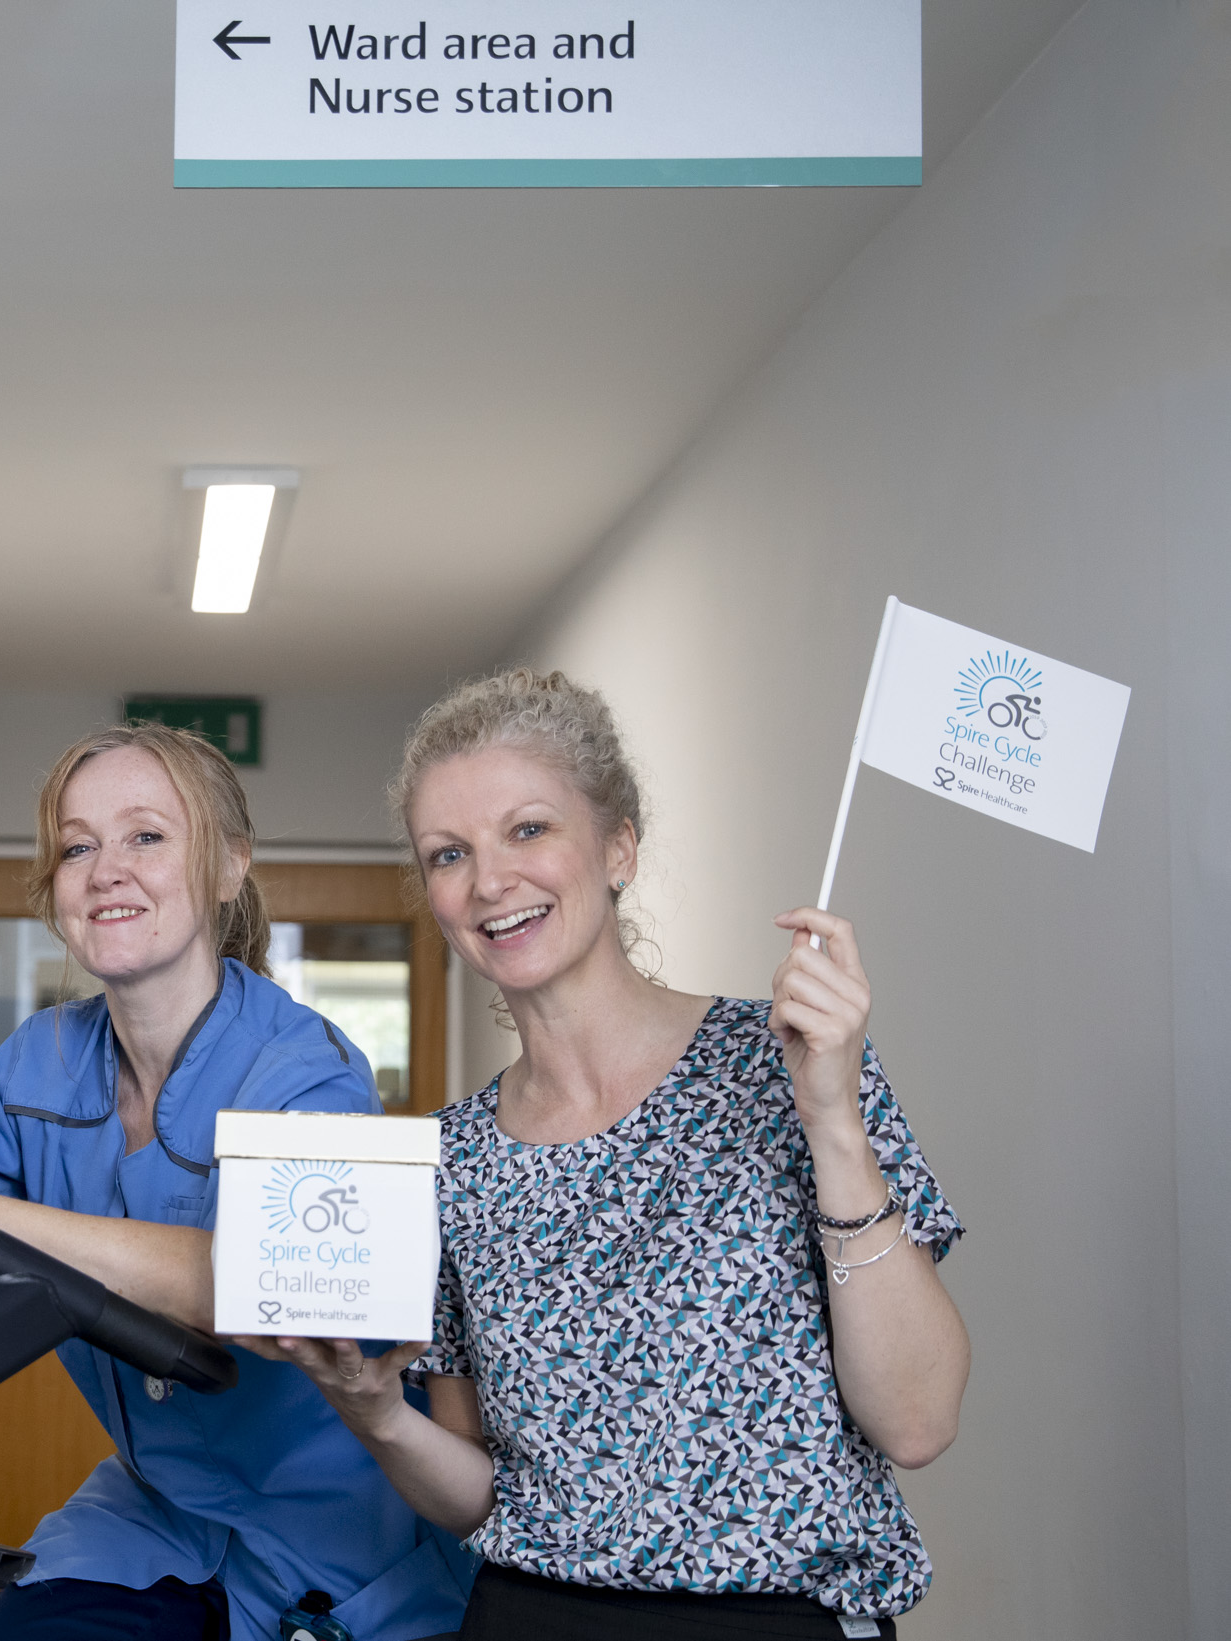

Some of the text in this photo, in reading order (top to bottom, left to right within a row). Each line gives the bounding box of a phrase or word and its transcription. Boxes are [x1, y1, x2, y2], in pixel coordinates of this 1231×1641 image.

[308, 20, 636, 61] Ward area and
[308, 76, 614, 115] Nurse station
[944, 716, 1042, 767] Spire Cycle
[940, 742, 1036, 794] Challenge
[957, 780, 1028, 814] Spire Healthcare
[259, 1239, 370, 1269] Spire Cycle
[259, 1270, 370, 1302] Challenge
[286, 1307, 367, 1321] Spire Healthcare
